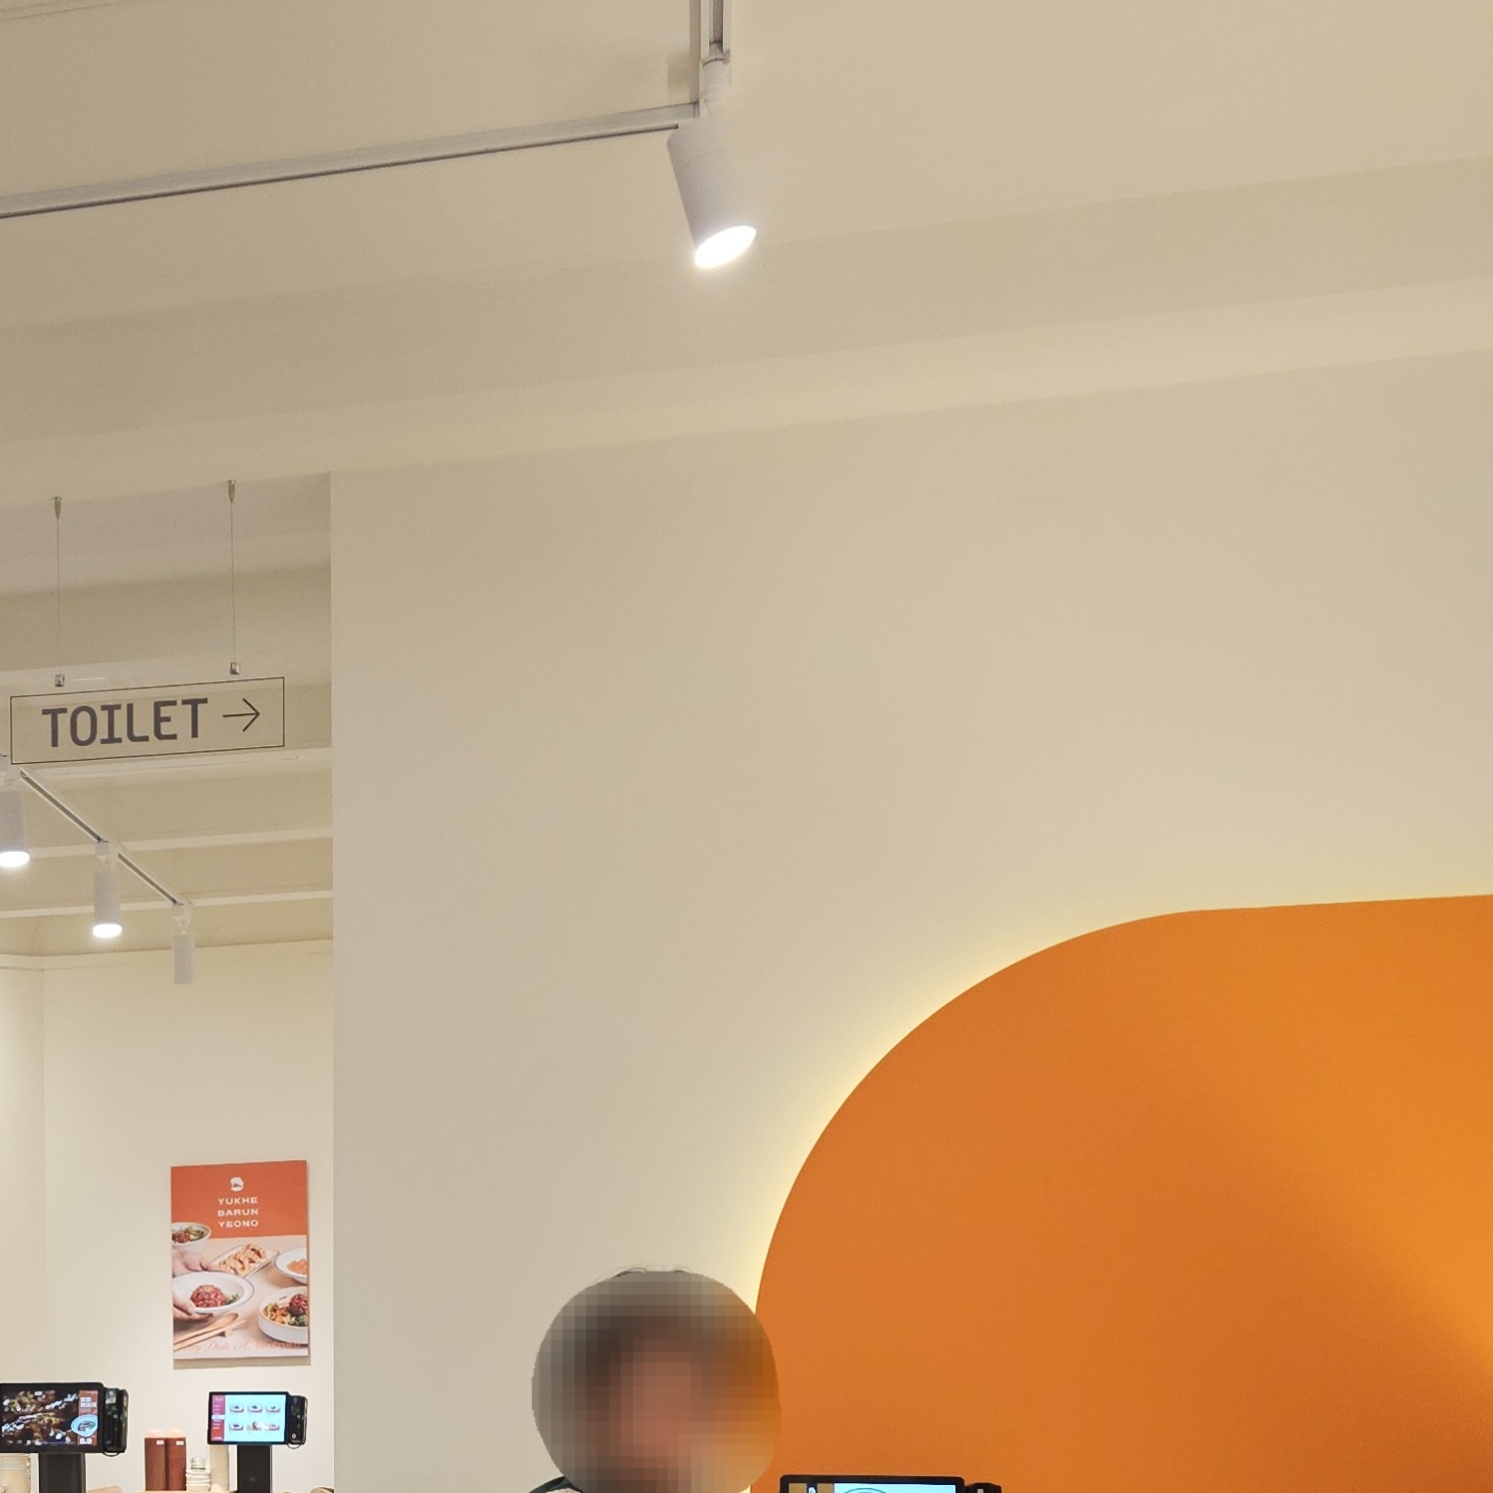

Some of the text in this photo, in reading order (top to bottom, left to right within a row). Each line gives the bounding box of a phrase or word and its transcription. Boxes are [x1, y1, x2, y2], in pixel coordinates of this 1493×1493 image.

[41, 697, 209, 748] TOILET
[217, 1196, 258, 1205] YUKHE
[217, 1208, 259, 1217] BARUN
[218, 1219, 259, 1228] YEONO
